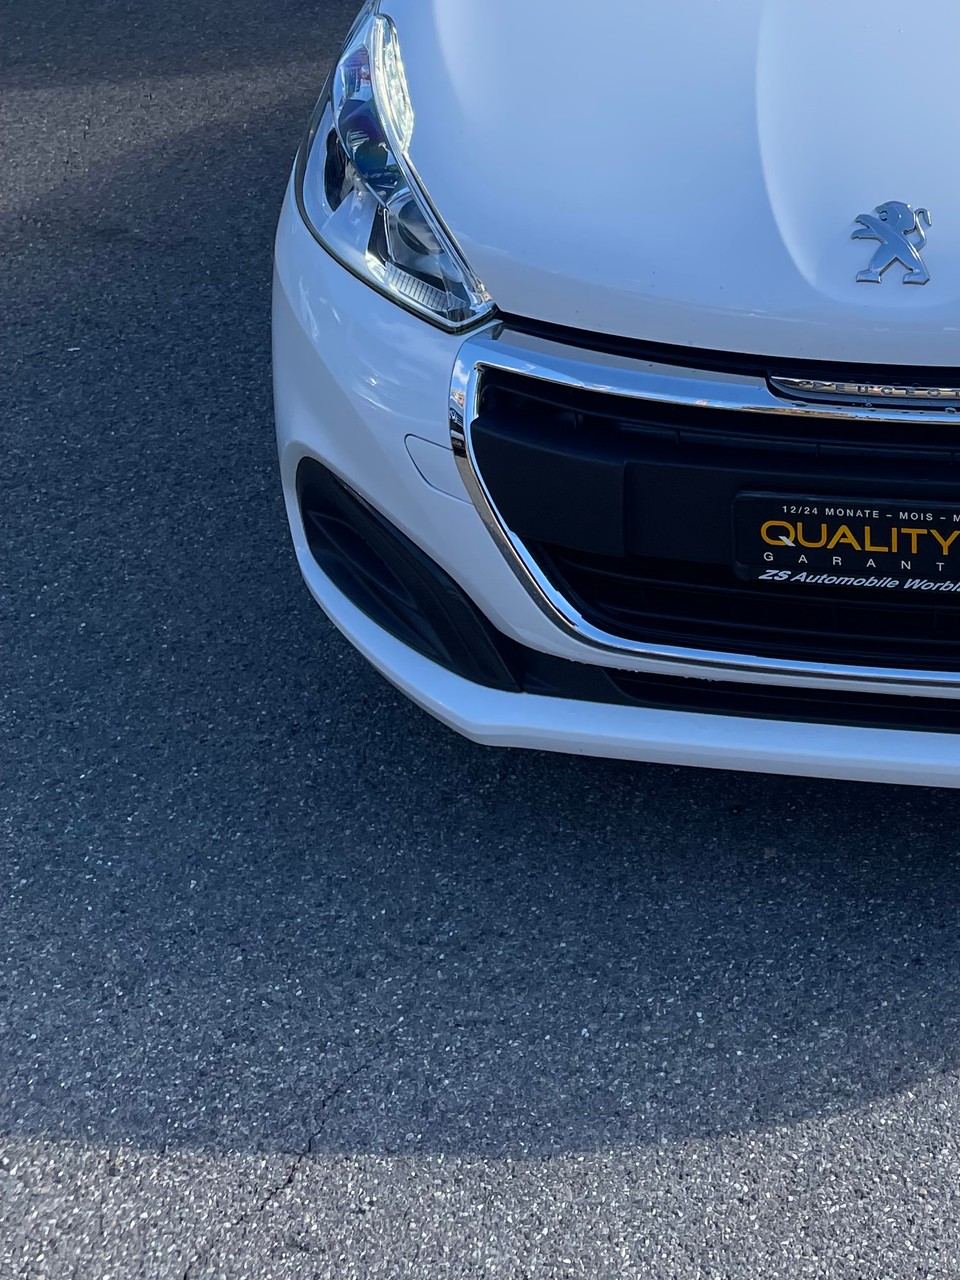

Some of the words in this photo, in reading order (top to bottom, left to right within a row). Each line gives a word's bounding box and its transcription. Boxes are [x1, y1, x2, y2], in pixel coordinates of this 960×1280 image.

[782, 505, 818, 515] 12/24
[825, 507, 880, 519] MONATE
[899, 511, 934, 521] MOIS
[760, 519, 960, 556] QUALITY
[758, 569, 792, 581] ZS
[790, 571, 900, 589] Automobile
